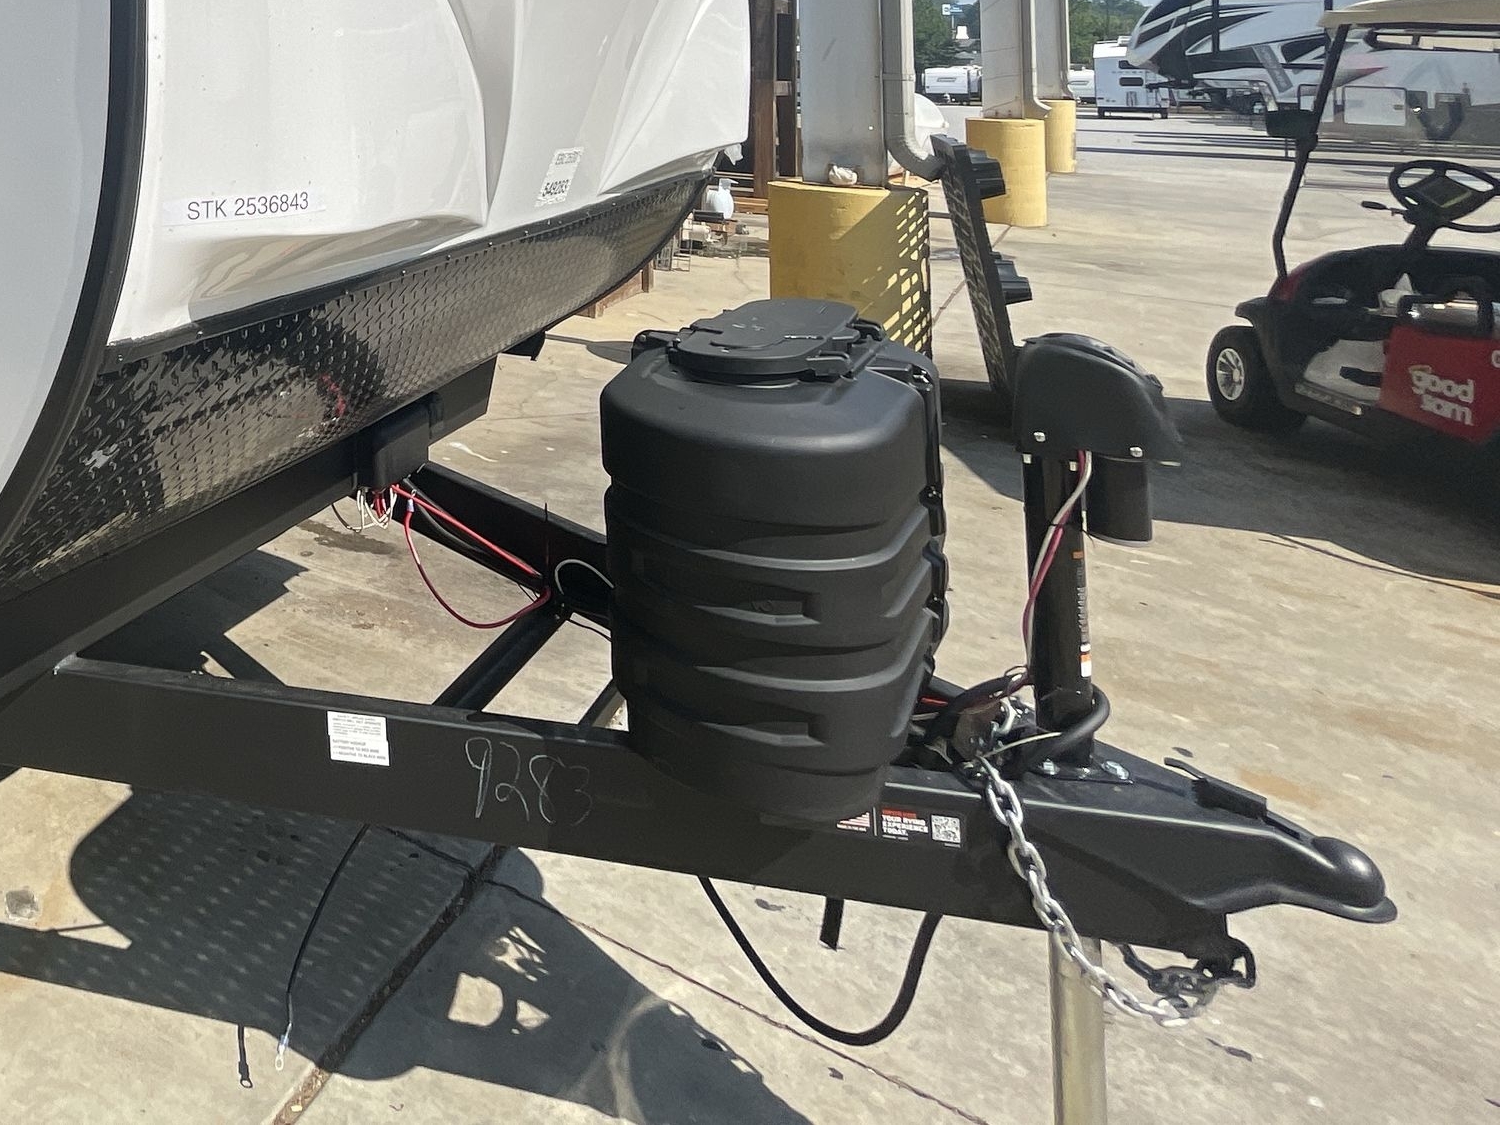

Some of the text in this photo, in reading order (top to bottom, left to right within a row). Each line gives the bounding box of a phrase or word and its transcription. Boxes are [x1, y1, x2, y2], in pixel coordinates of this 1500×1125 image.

[187, 191, 309, 221] STK 2536843
[1410, 369, 1476, 405] good
[1420, 392, 1475, 427] sam
[465, 736, 593, 826] 9283
